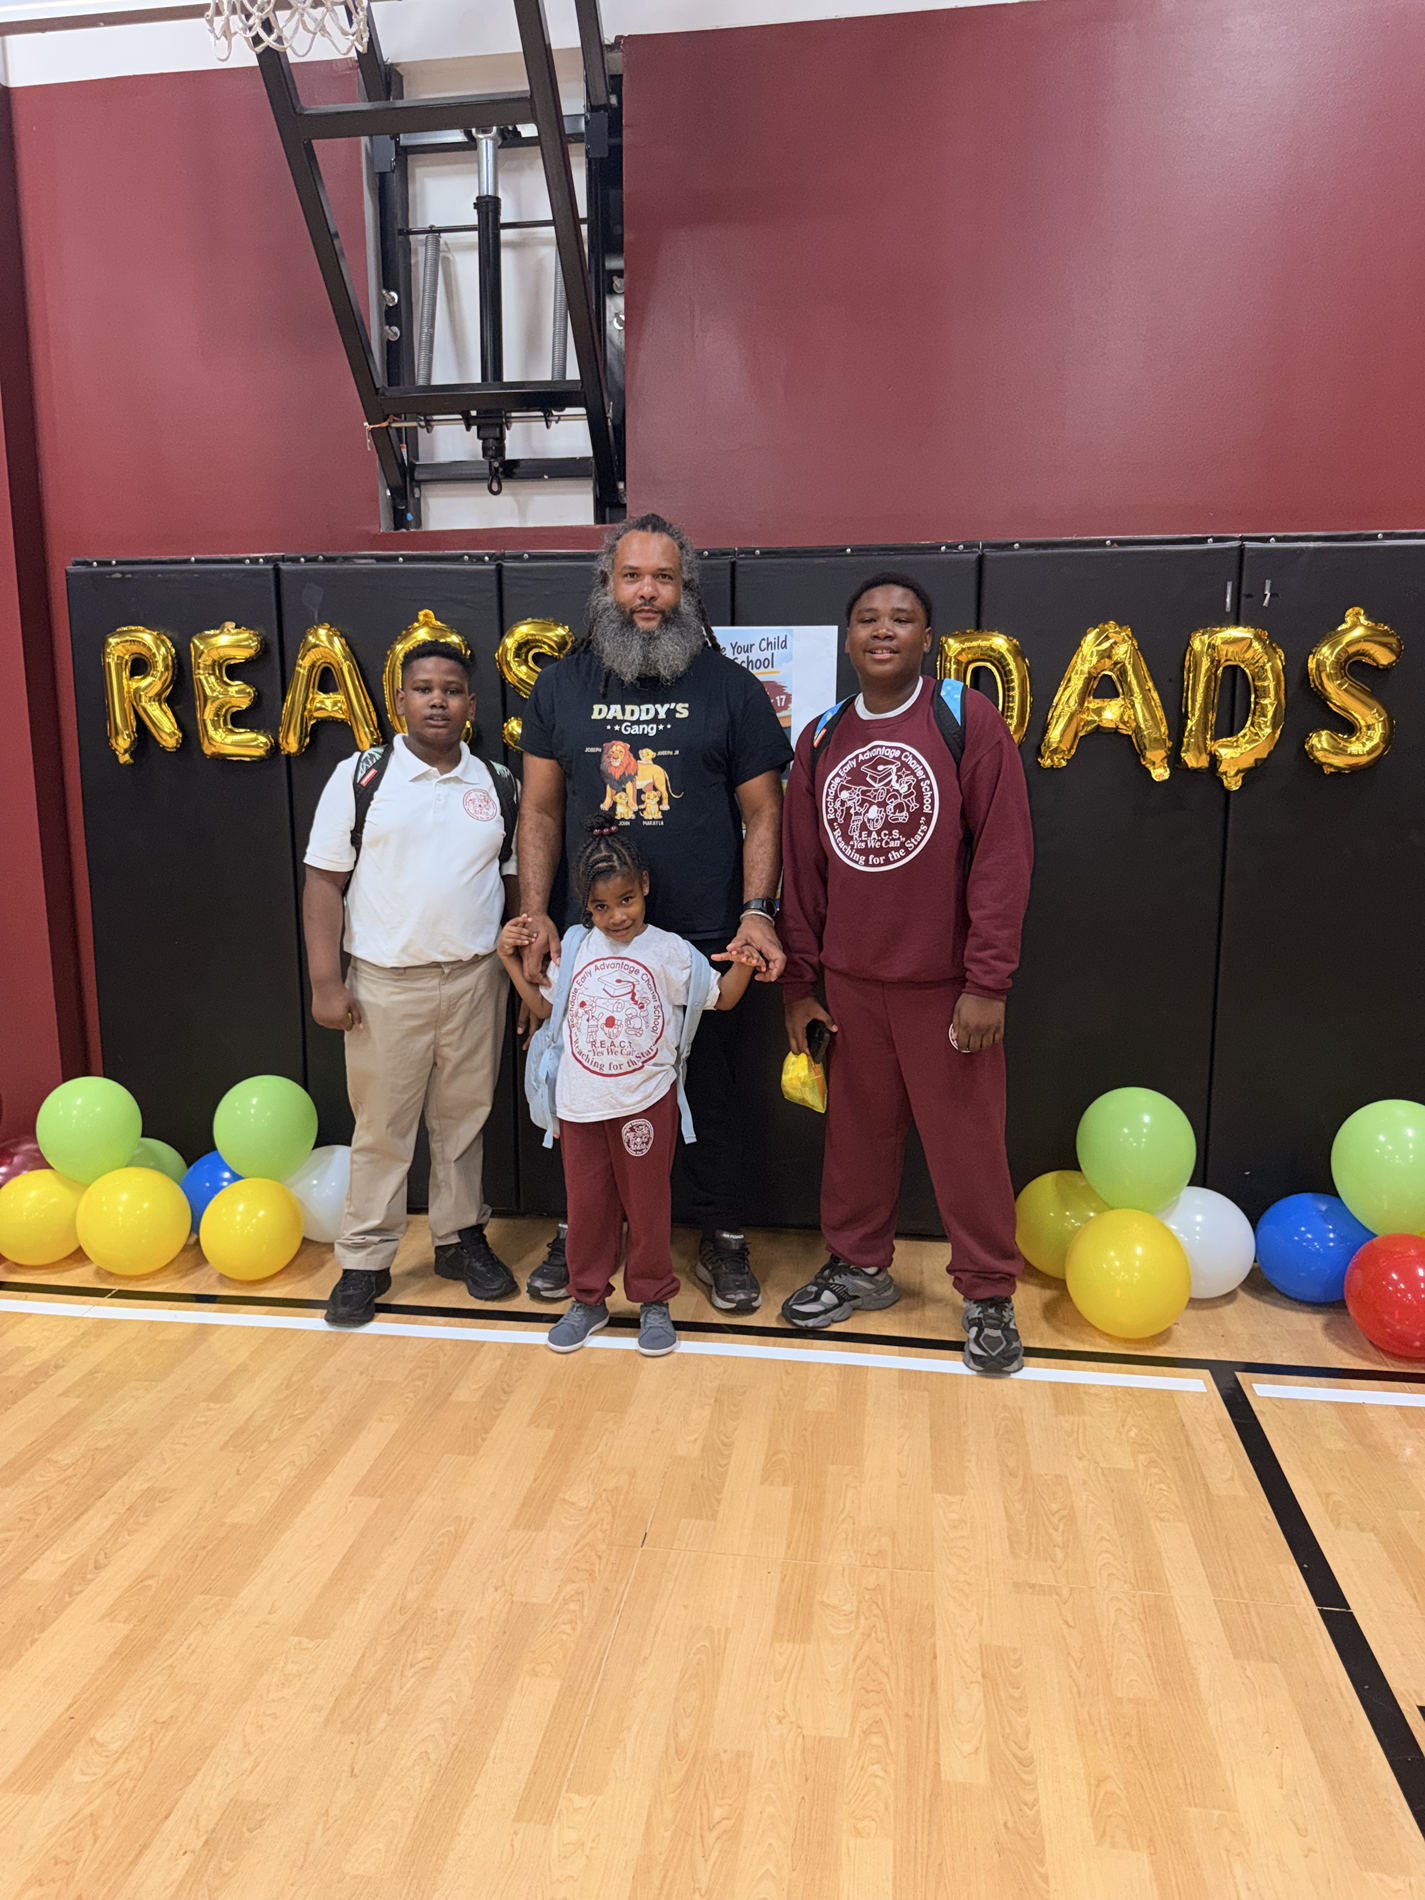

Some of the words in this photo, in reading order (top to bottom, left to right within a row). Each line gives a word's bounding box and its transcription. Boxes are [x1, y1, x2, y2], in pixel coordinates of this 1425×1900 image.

[730, 641, 755, 656] Your
[758, 634, 788, 652] Child
[775, 695, 787, 707] 17
[937, 607, 1405, 790] DADS
[591, 703, 690, 721] DADDY'S
[621, 722, 657, 736] Gang
[826, 776, 841, 820] Rochdale
[838, 760, 857, 777] Early
[858, 747, 901, 762] Advantage
[901, 752, 926, 780] Charter
[920, 780, 933, 814] School
[867, 840, 881, 848] We
[868, 855, 885, 865] for
[888, 848, 906, 862] the
[576, 969, 593, 987] Early
[594, 962, 640, 976] Advantage
[651, 1004, 662, 1035] School
[606, 1048, 619, 1056] We
[608, 1061, 624, 1071] for
[627, 1059, 638, 1068] th
